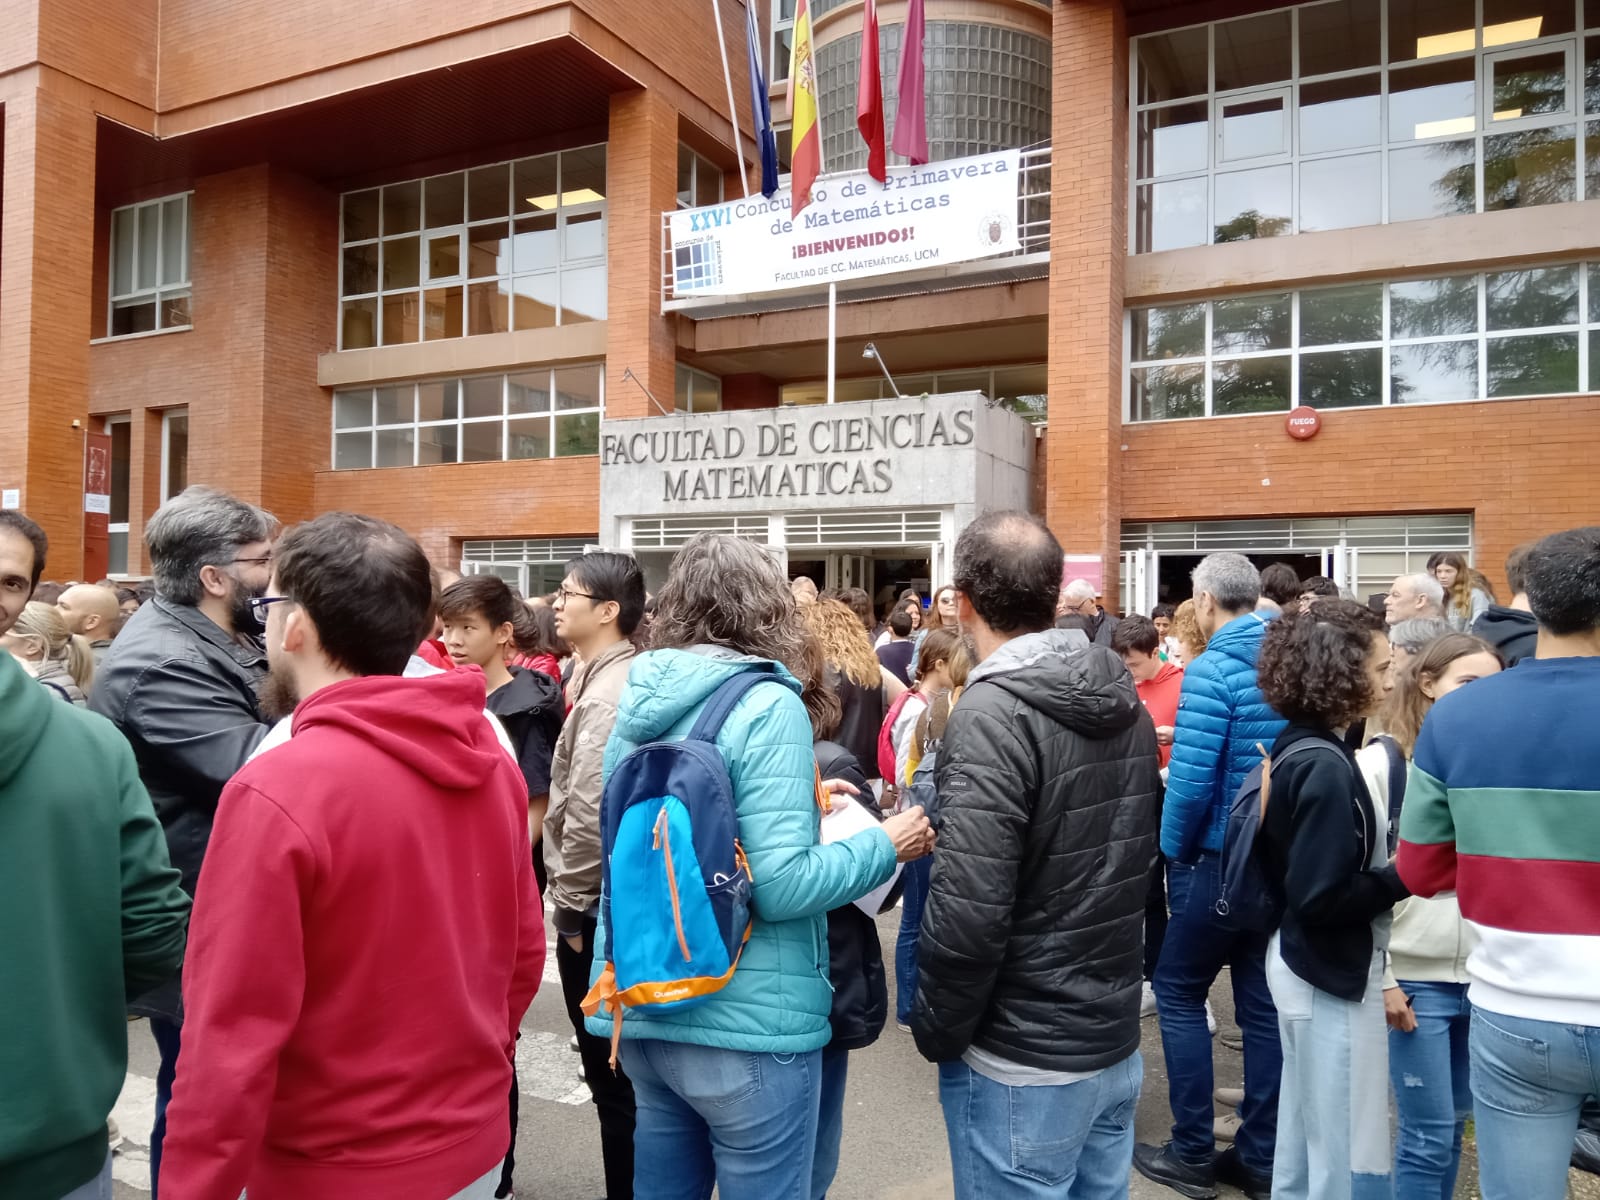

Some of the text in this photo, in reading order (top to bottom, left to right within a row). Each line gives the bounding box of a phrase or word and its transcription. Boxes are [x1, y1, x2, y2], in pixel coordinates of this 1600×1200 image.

[690, 159, 1008, 232] XXVI Concuo de Primavera
[770, 194, 950, 235] de Matemáticas
[792, 227, 915, 260] ¡BIENVENIDOS!
[914, 248, 939, 261] UCM
[601, 410, 974, 466] FACULTAD DE CIENCIAS
[1290, 417, 1316, 426] FUEGO
[663, 458, 893, 502] MATEMATICAS
